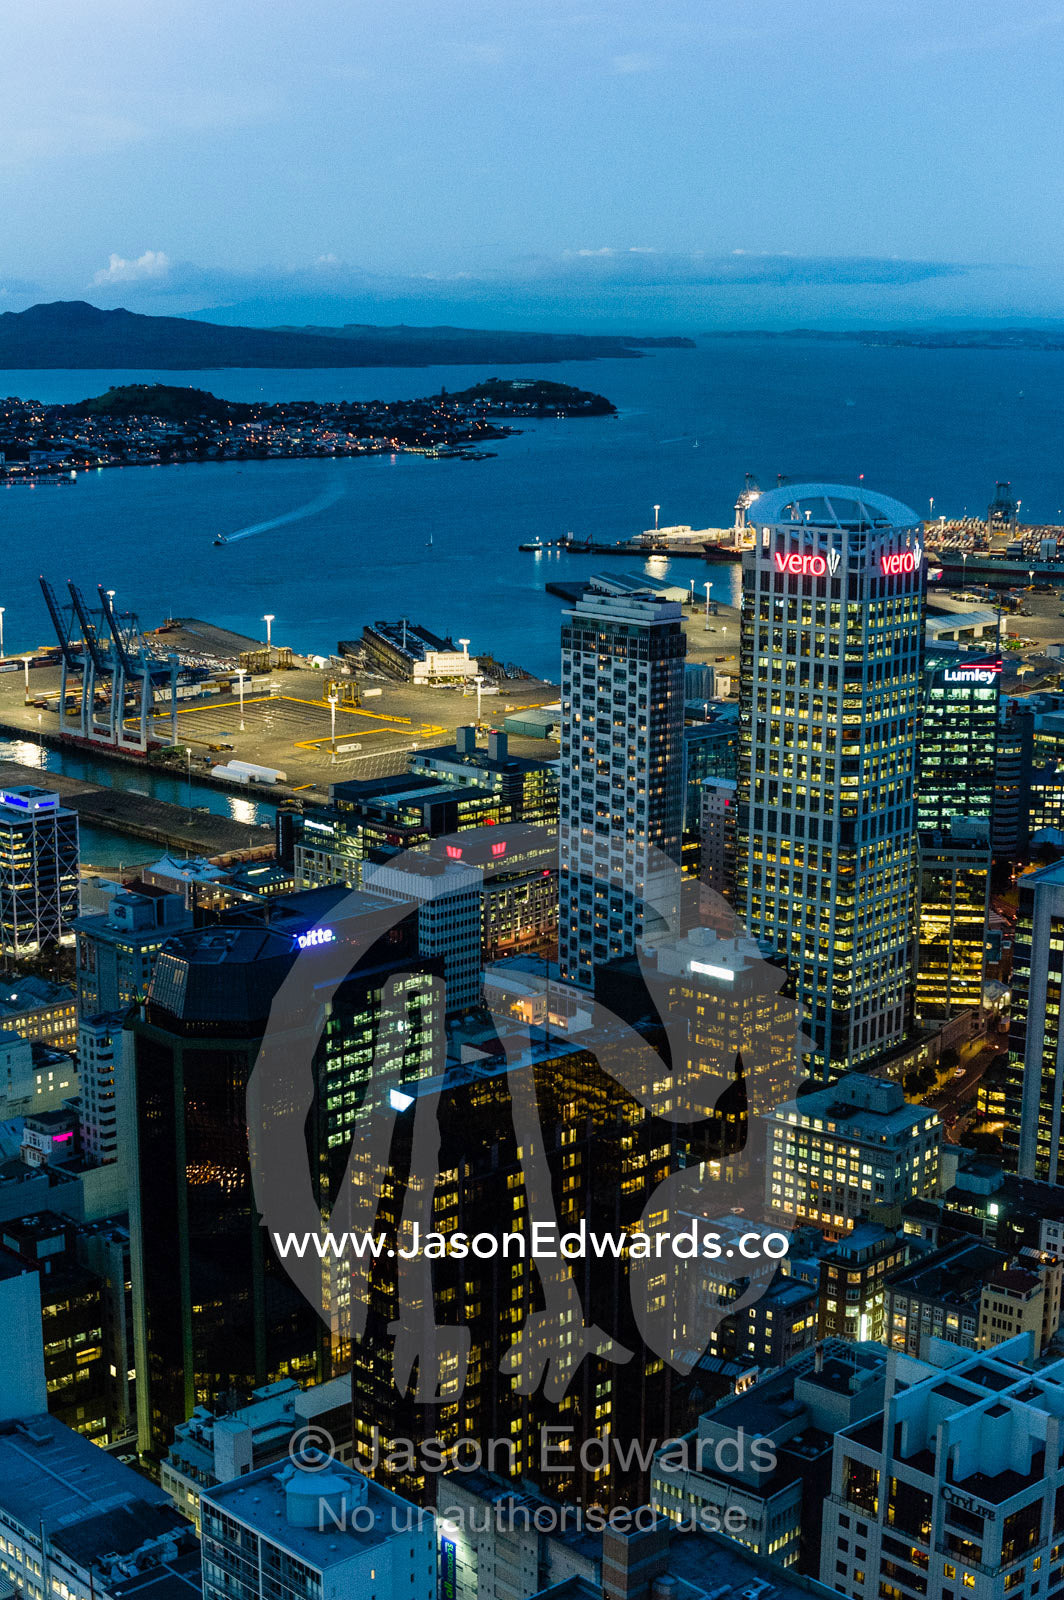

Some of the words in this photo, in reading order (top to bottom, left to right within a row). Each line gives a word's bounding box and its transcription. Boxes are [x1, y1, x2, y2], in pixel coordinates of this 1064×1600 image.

[776, 552, 826, 575] vero
[882, 552, 914, 574] vero
[944, 668, 997, 685] Lumley
